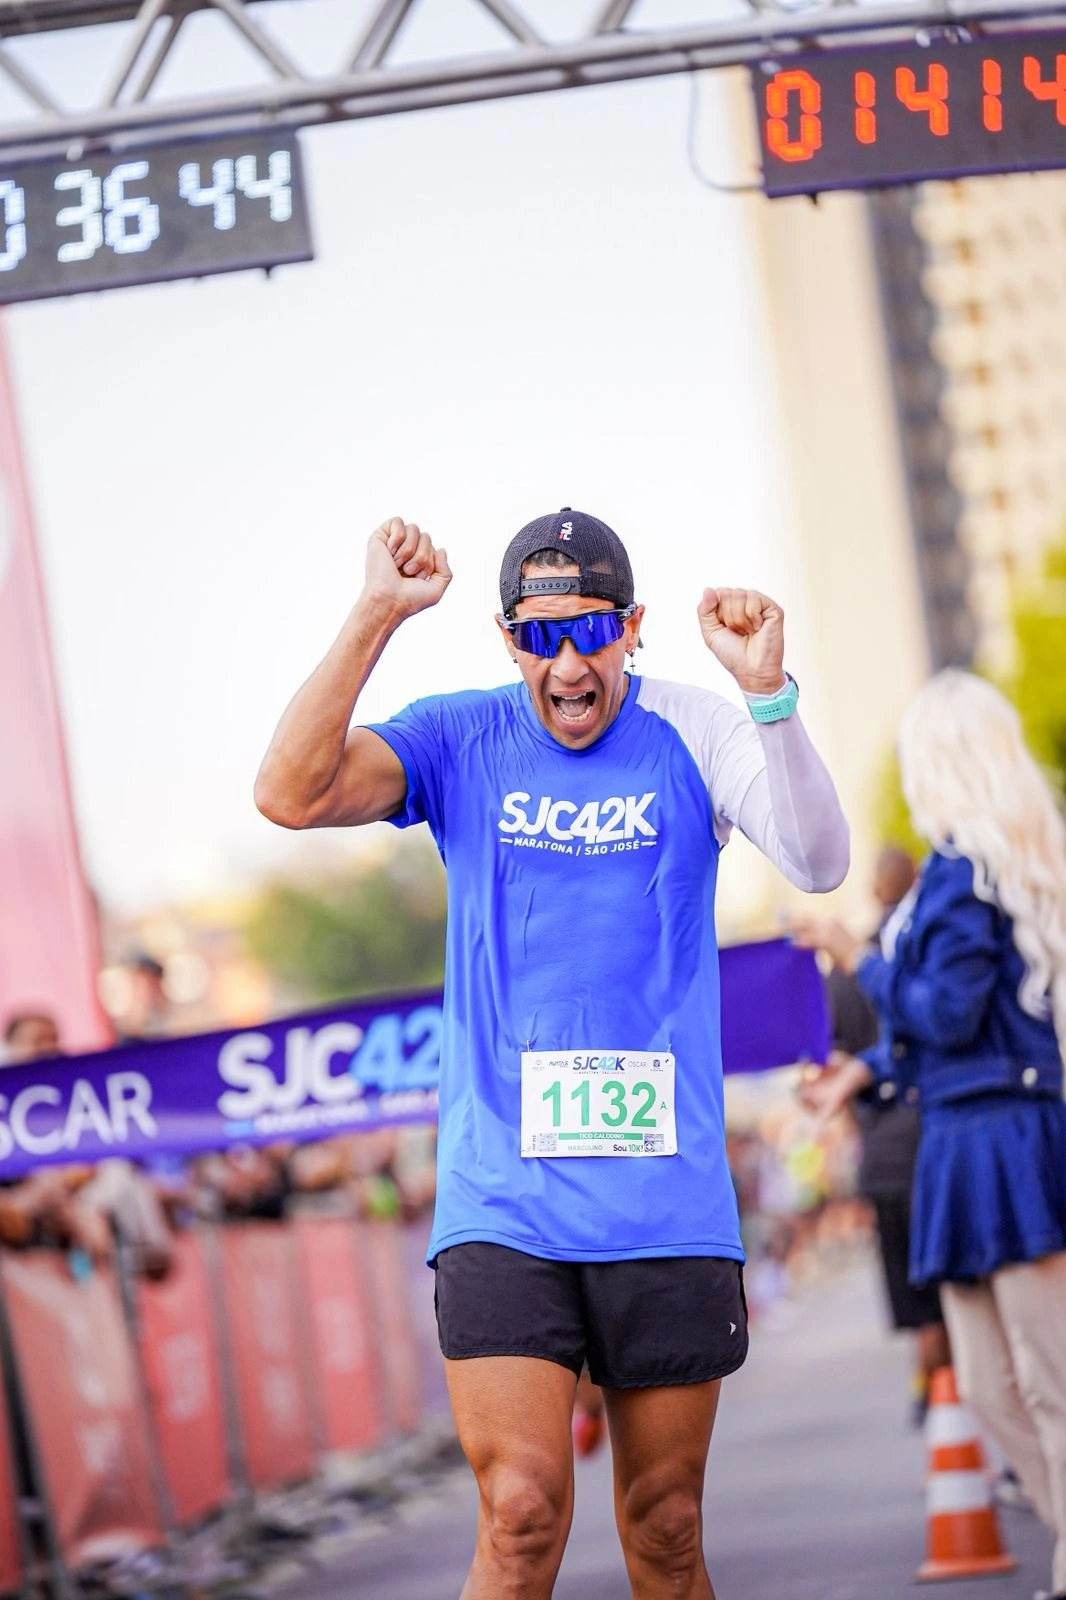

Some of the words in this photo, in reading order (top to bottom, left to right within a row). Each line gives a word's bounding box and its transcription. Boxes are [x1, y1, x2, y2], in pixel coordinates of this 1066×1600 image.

[54, 161, 161, 262] 36
[179, 150, 292, 230] 44
[498, 791, 658, 845] SJC42K
[514, 837, 573, 855] MARATONA
[584, 843, 608, 856] SÃO
[611, 838, 640, 853] JOSÉ
[573, 1056, 626, 1071] SJC42K
[542, 1080, 657, 1127] 1132
[660, 1101, 667, 1110] A
[568, 1144, 603, 1152] MASCULINO
[613, 1144, 627, 1152] Sou
